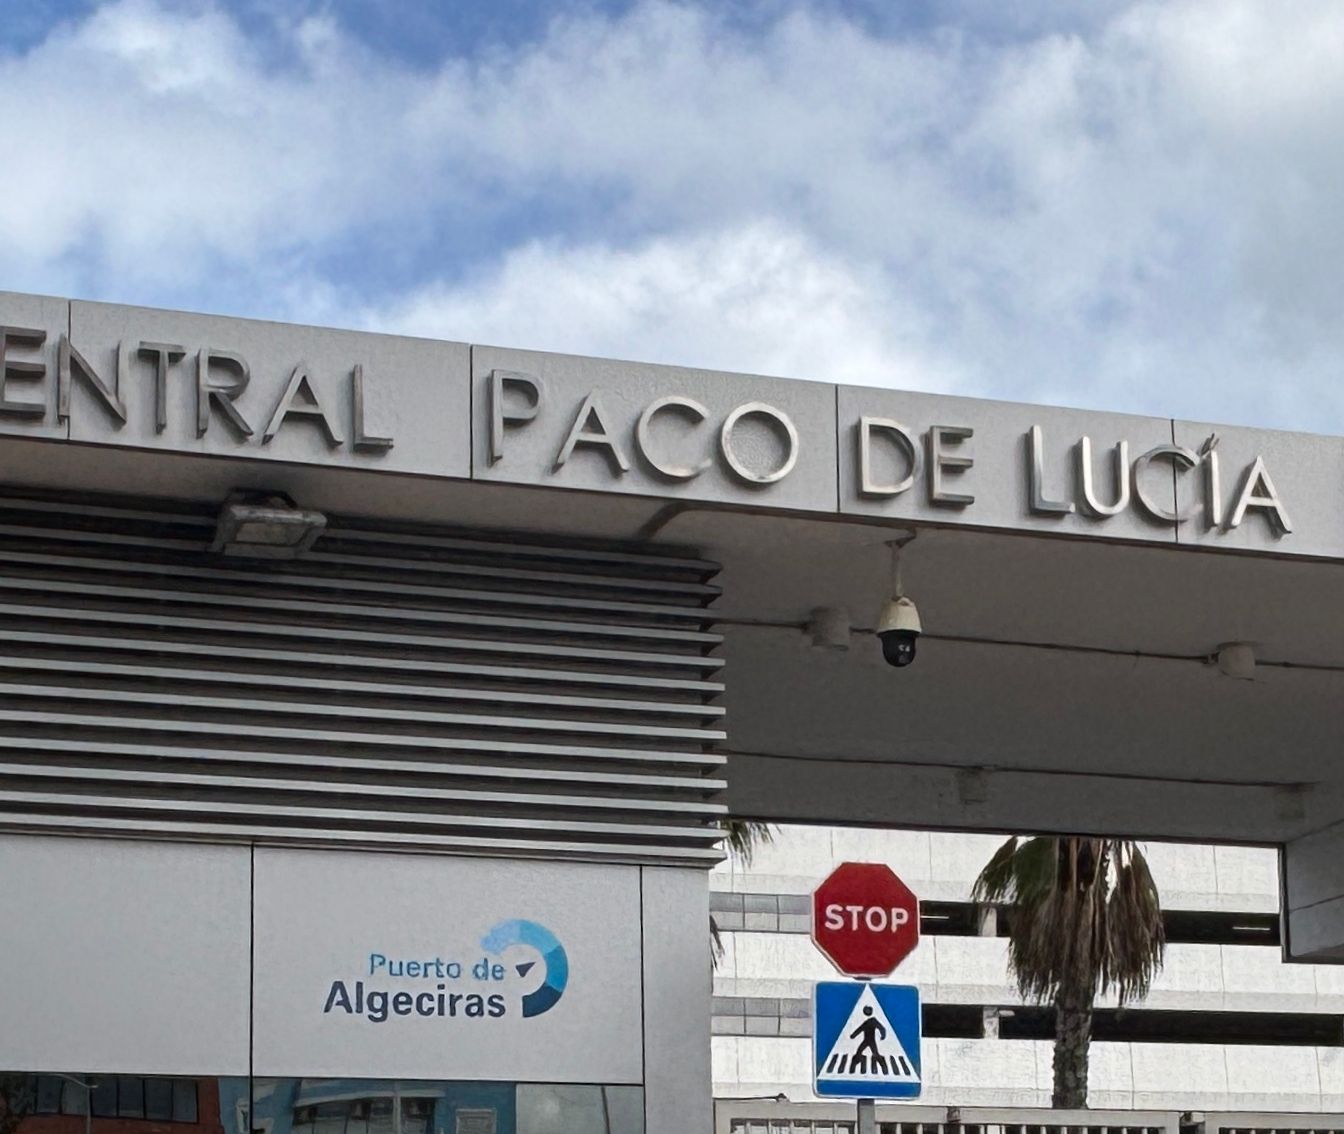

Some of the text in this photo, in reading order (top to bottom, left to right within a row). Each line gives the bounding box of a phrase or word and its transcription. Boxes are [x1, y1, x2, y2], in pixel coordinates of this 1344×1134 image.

[490, 369, 798, 486] PACO
[857, 416, 975, 506] DE
[1029, 424, 1293, 538] LUCÍA
[824, 903, 909, 933] STOP
[369, 954, 506, 981] Puerto de
[324, 980, 506, 1023] Algeciras
